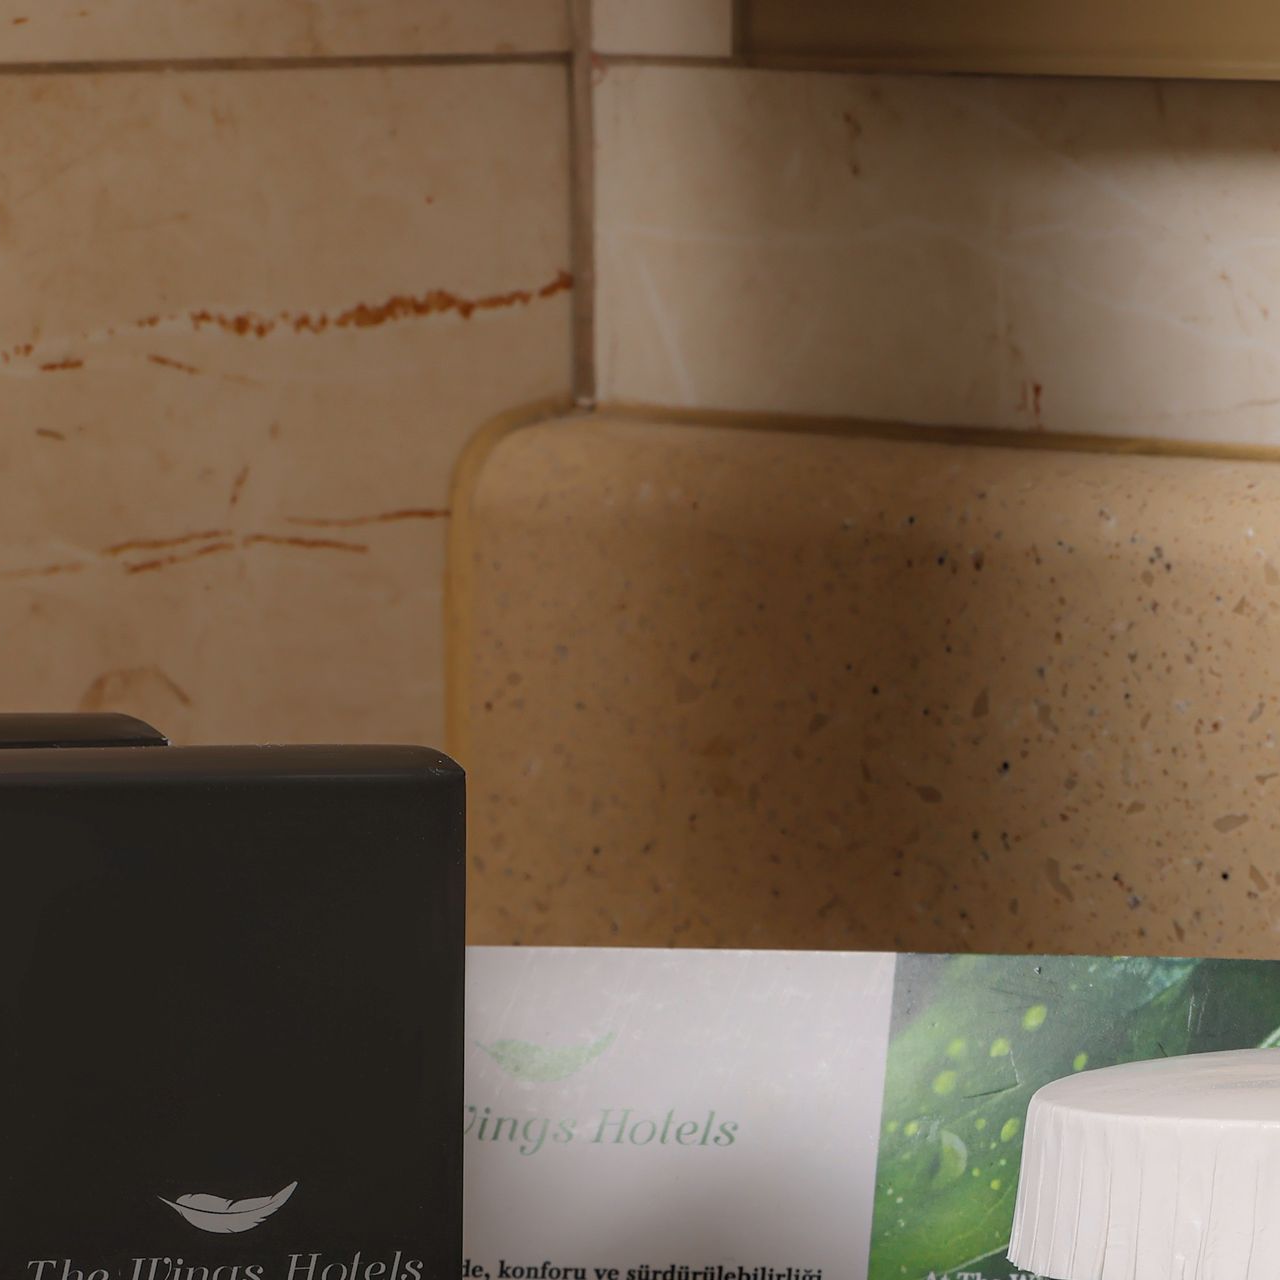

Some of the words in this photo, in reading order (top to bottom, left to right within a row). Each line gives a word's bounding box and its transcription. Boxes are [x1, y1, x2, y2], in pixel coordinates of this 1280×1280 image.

[464, 1105, 577, 1156] ings
[591, 1108, 739, 1149] Hotels
[498, 1260, 587, 1280] konforu
[594, 1268, 620, 1280] ve
